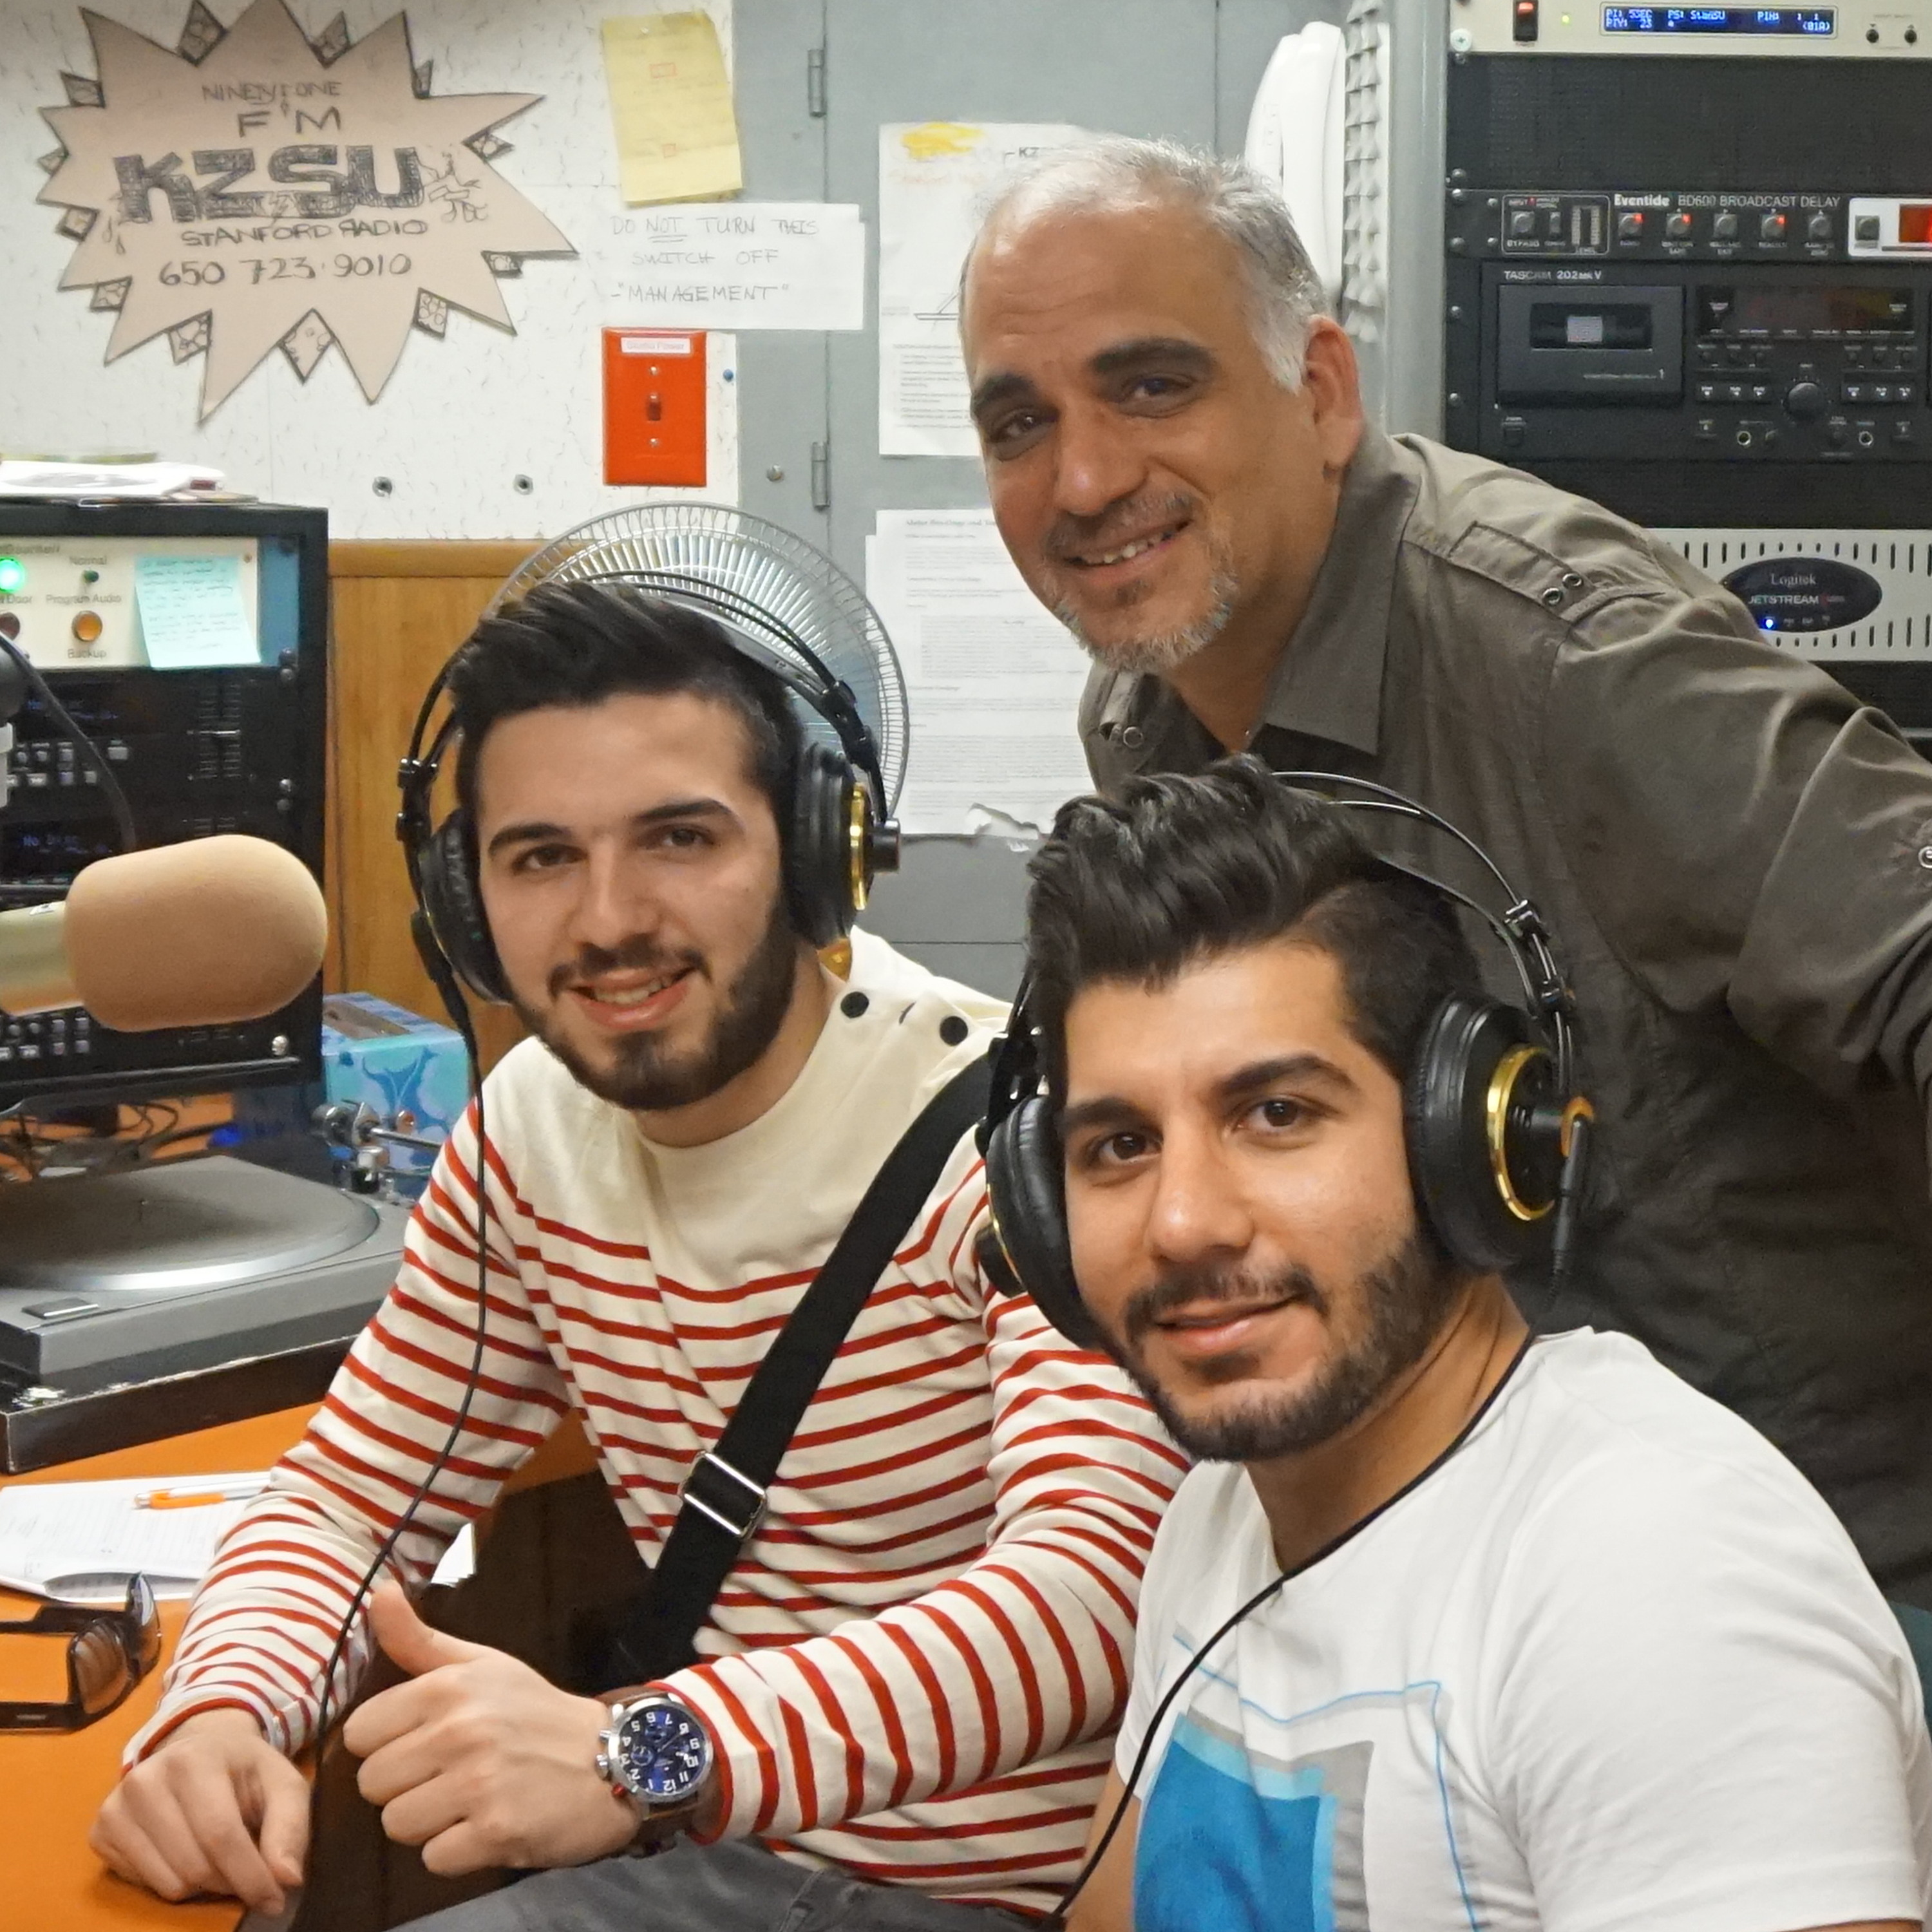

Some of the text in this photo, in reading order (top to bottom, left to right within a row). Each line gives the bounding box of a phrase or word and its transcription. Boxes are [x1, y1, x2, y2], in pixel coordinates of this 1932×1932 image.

[114, 145, 425, 222] KZSU
[1614, 194, 1841, 207] Eventide BD600 BROADCAST DELAY
[182, 218, 428, 246] STANFORD RADIO
[611, 216, 636, 234] DO
[647, 216, 684, 234] NOT
[696, 216, 755, 234] TURN
[632, 249, 779, 265] SWITCH OFF
[159, 261, 225, 286] 650
[1504, 270, 1552, 279] TASCAM
[1771, 573, 1817, 587] Logitek
[1748, 594, 1819, 604] JETSTREAM
